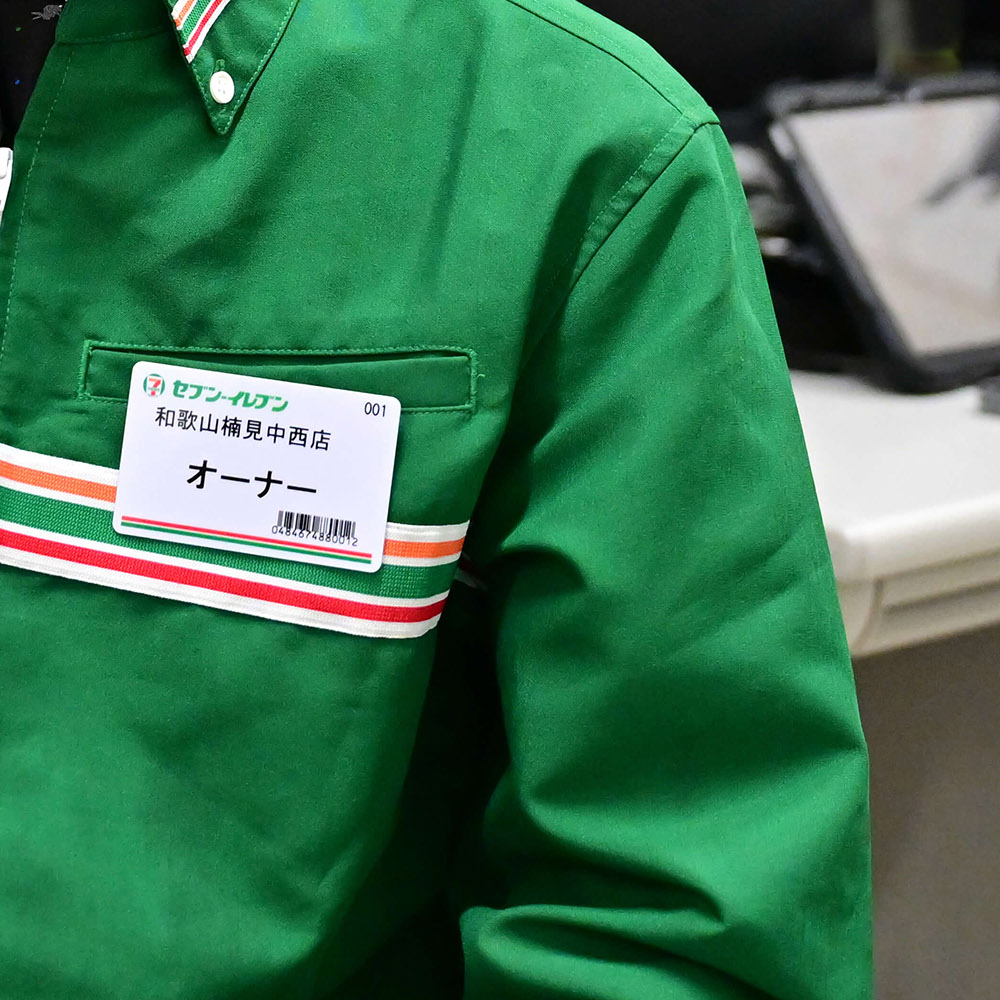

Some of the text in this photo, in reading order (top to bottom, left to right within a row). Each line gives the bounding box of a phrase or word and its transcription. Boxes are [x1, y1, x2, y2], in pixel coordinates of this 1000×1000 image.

[364, 401, 386, 417] 001
[155, 406, 331, 451] 和歌山楠見中西店
[187, 460, 317, 498] オーナー
